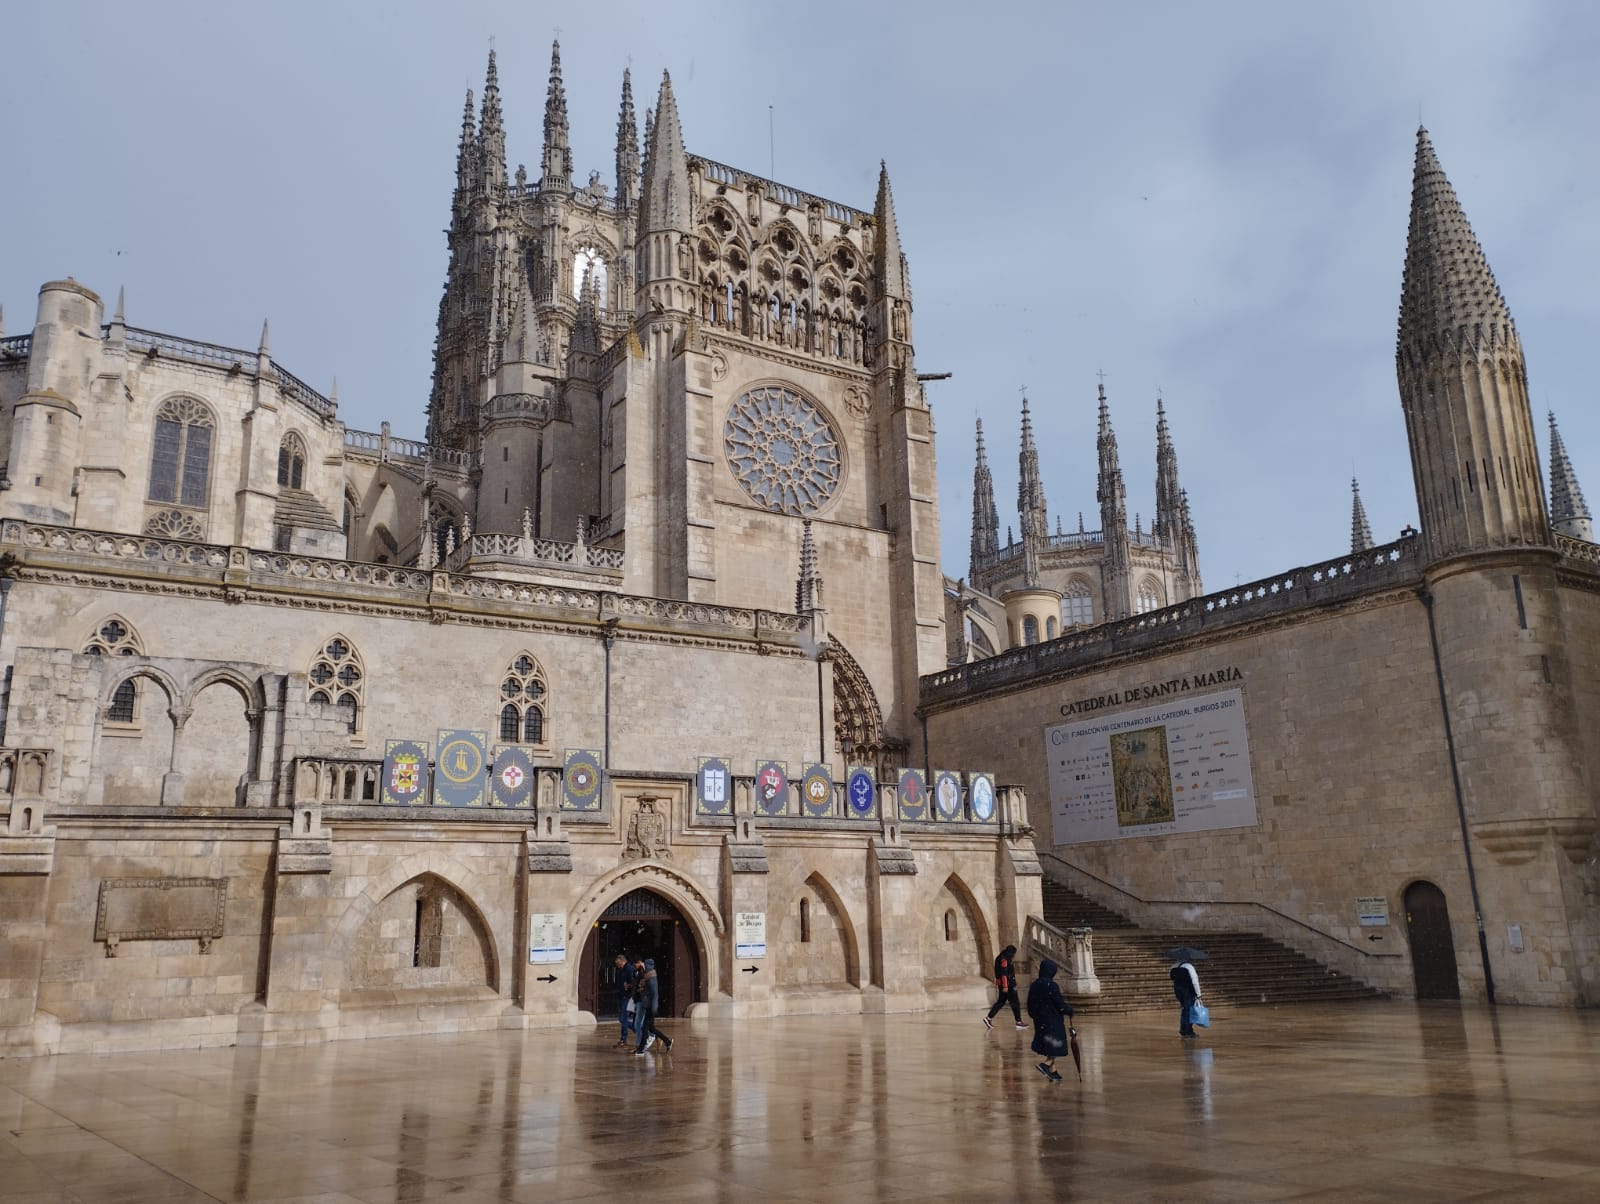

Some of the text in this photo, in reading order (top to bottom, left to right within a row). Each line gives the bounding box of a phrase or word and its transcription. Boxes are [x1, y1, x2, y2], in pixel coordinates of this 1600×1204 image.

[1060, 666, 1243, 717] CATEDRAL DE SANTA MARÍA
[1110, 718, 1143, 731] CENTENARIO
[1144, 716, 1152, 724] DE
[1153, 714, 1161, 722] LA
[1193, 702, 1219, 714] BURGOS
[1220, 699, 1236, 709] 2021
